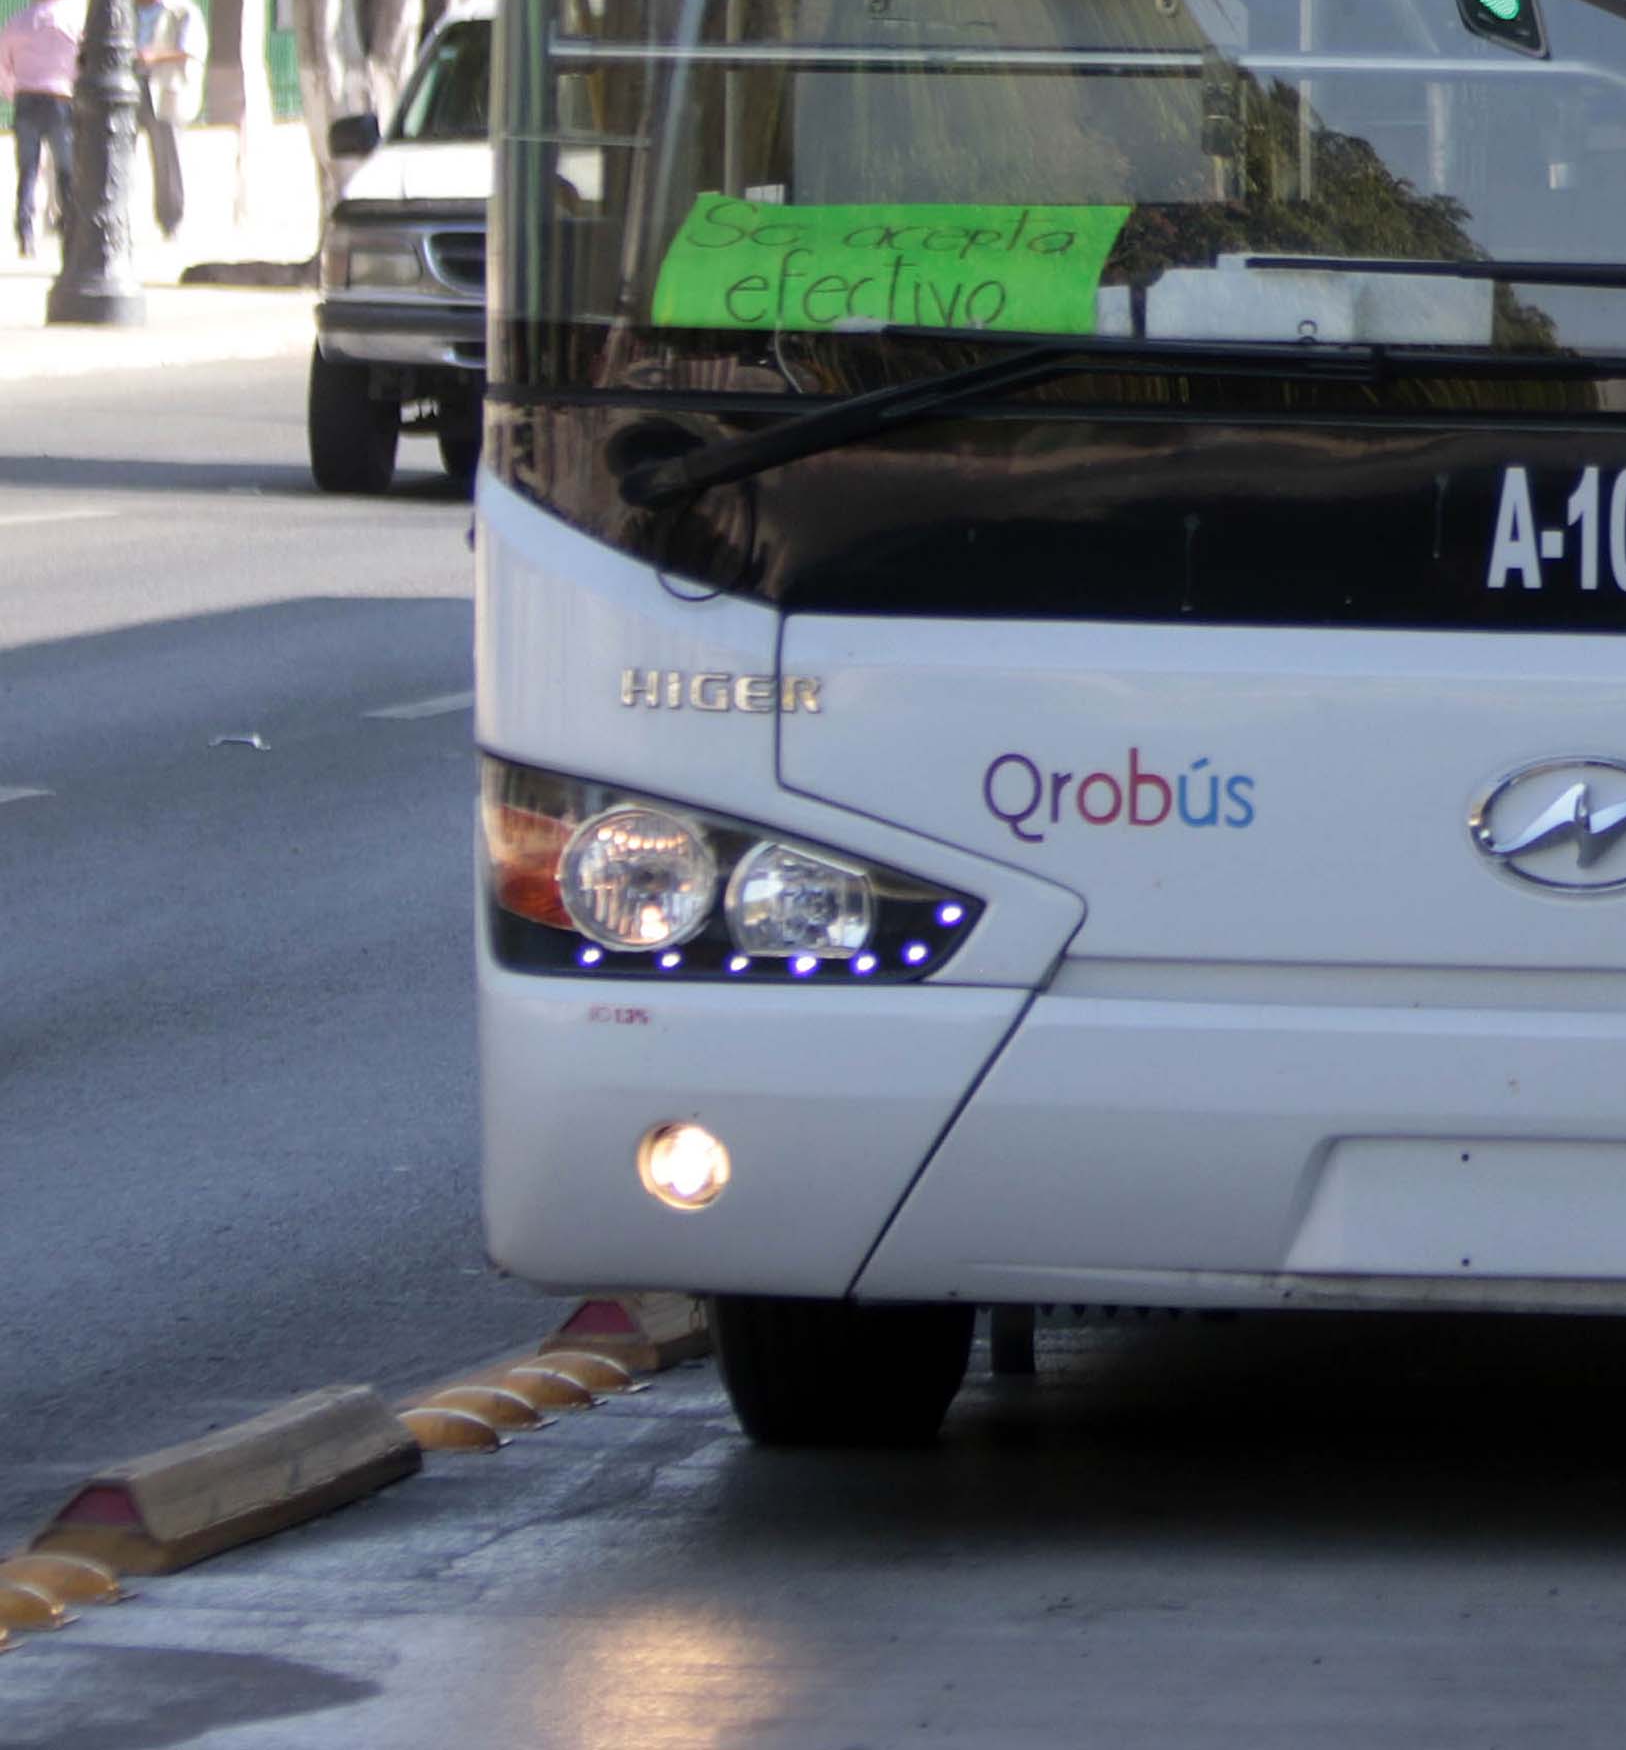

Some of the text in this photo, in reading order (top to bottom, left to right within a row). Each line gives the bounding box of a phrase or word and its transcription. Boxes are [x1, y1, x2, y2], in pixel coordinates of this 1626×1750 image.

[686, 201, 1076, 256] Se acepta
[724, 248, 1006, 326] efectivo
[982, 747, 1256, 843] Qrobús
